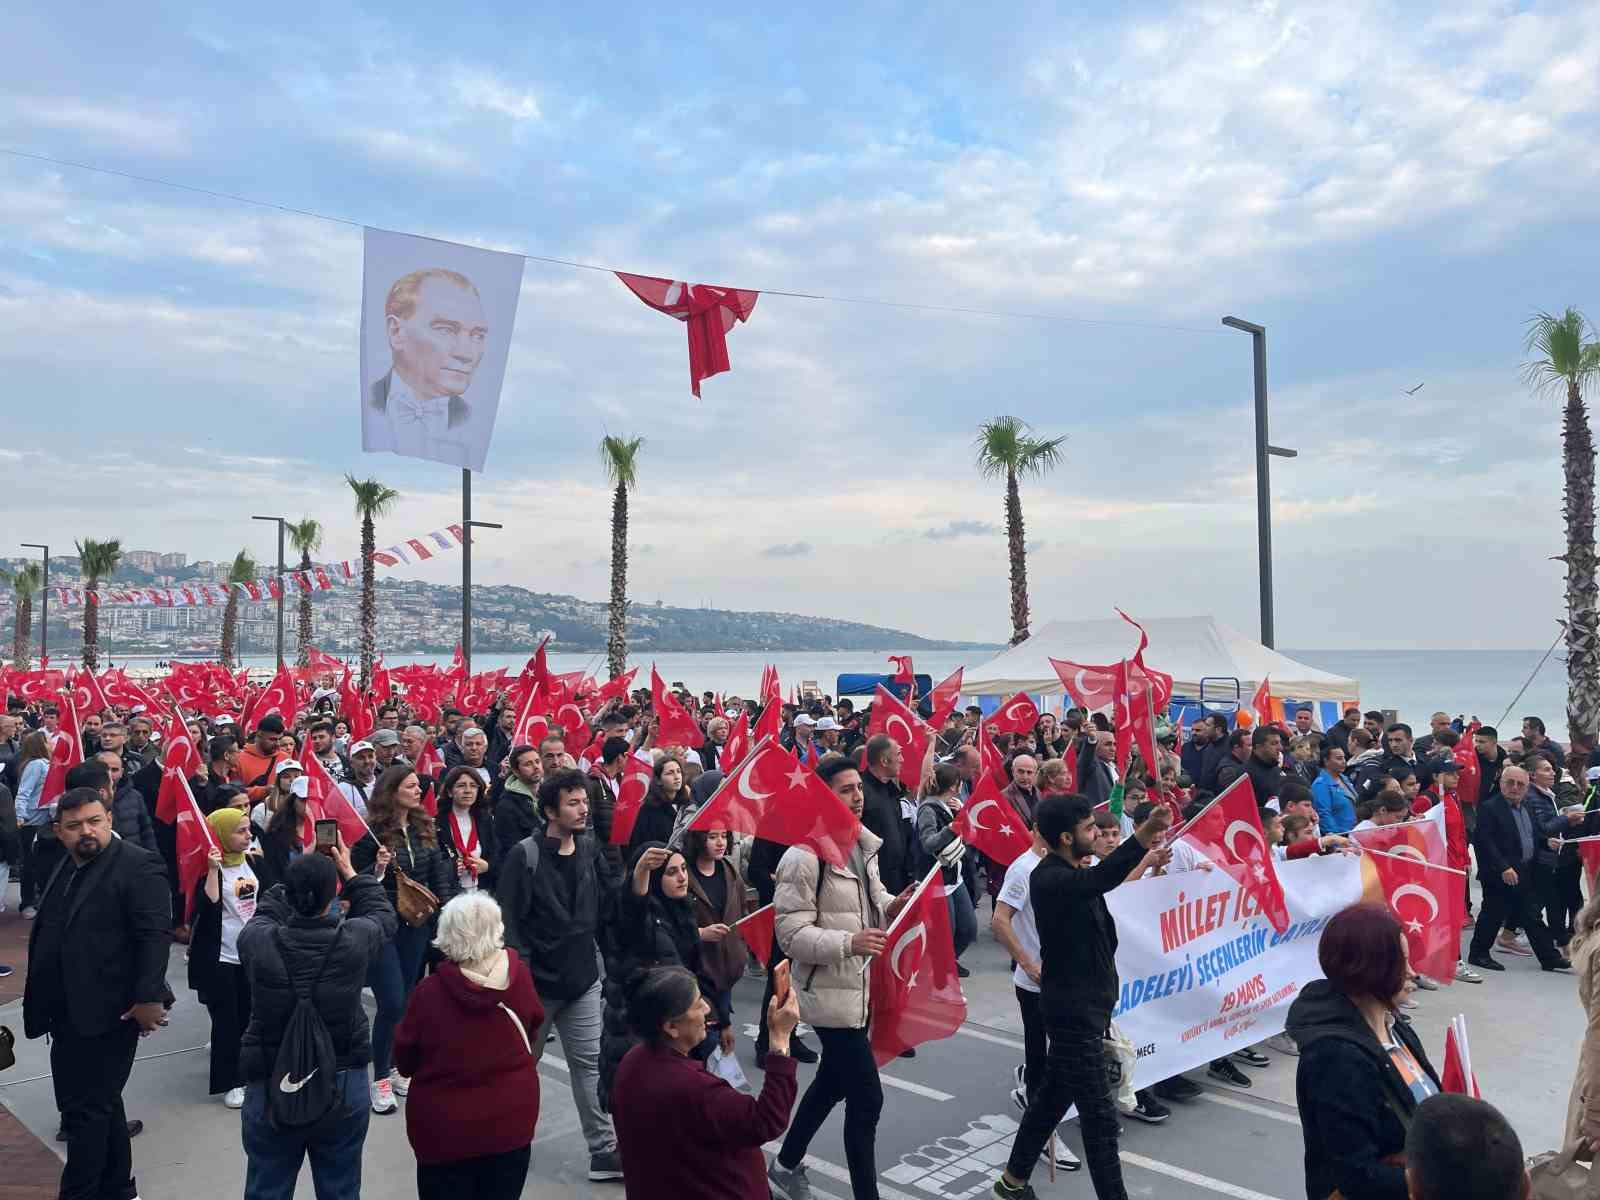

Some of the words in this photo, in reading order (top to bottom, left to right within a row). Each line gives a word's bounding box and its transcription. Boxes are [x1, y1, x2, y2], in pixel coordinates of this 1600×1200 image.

[1160, 891, 1231, 954] MİLLET
[1196, 922, 1268, 987] SEÇENLERİN
[1220, 992, 1236, 1013] 19
[1236, 974, 1266, 1008] MAYIS
